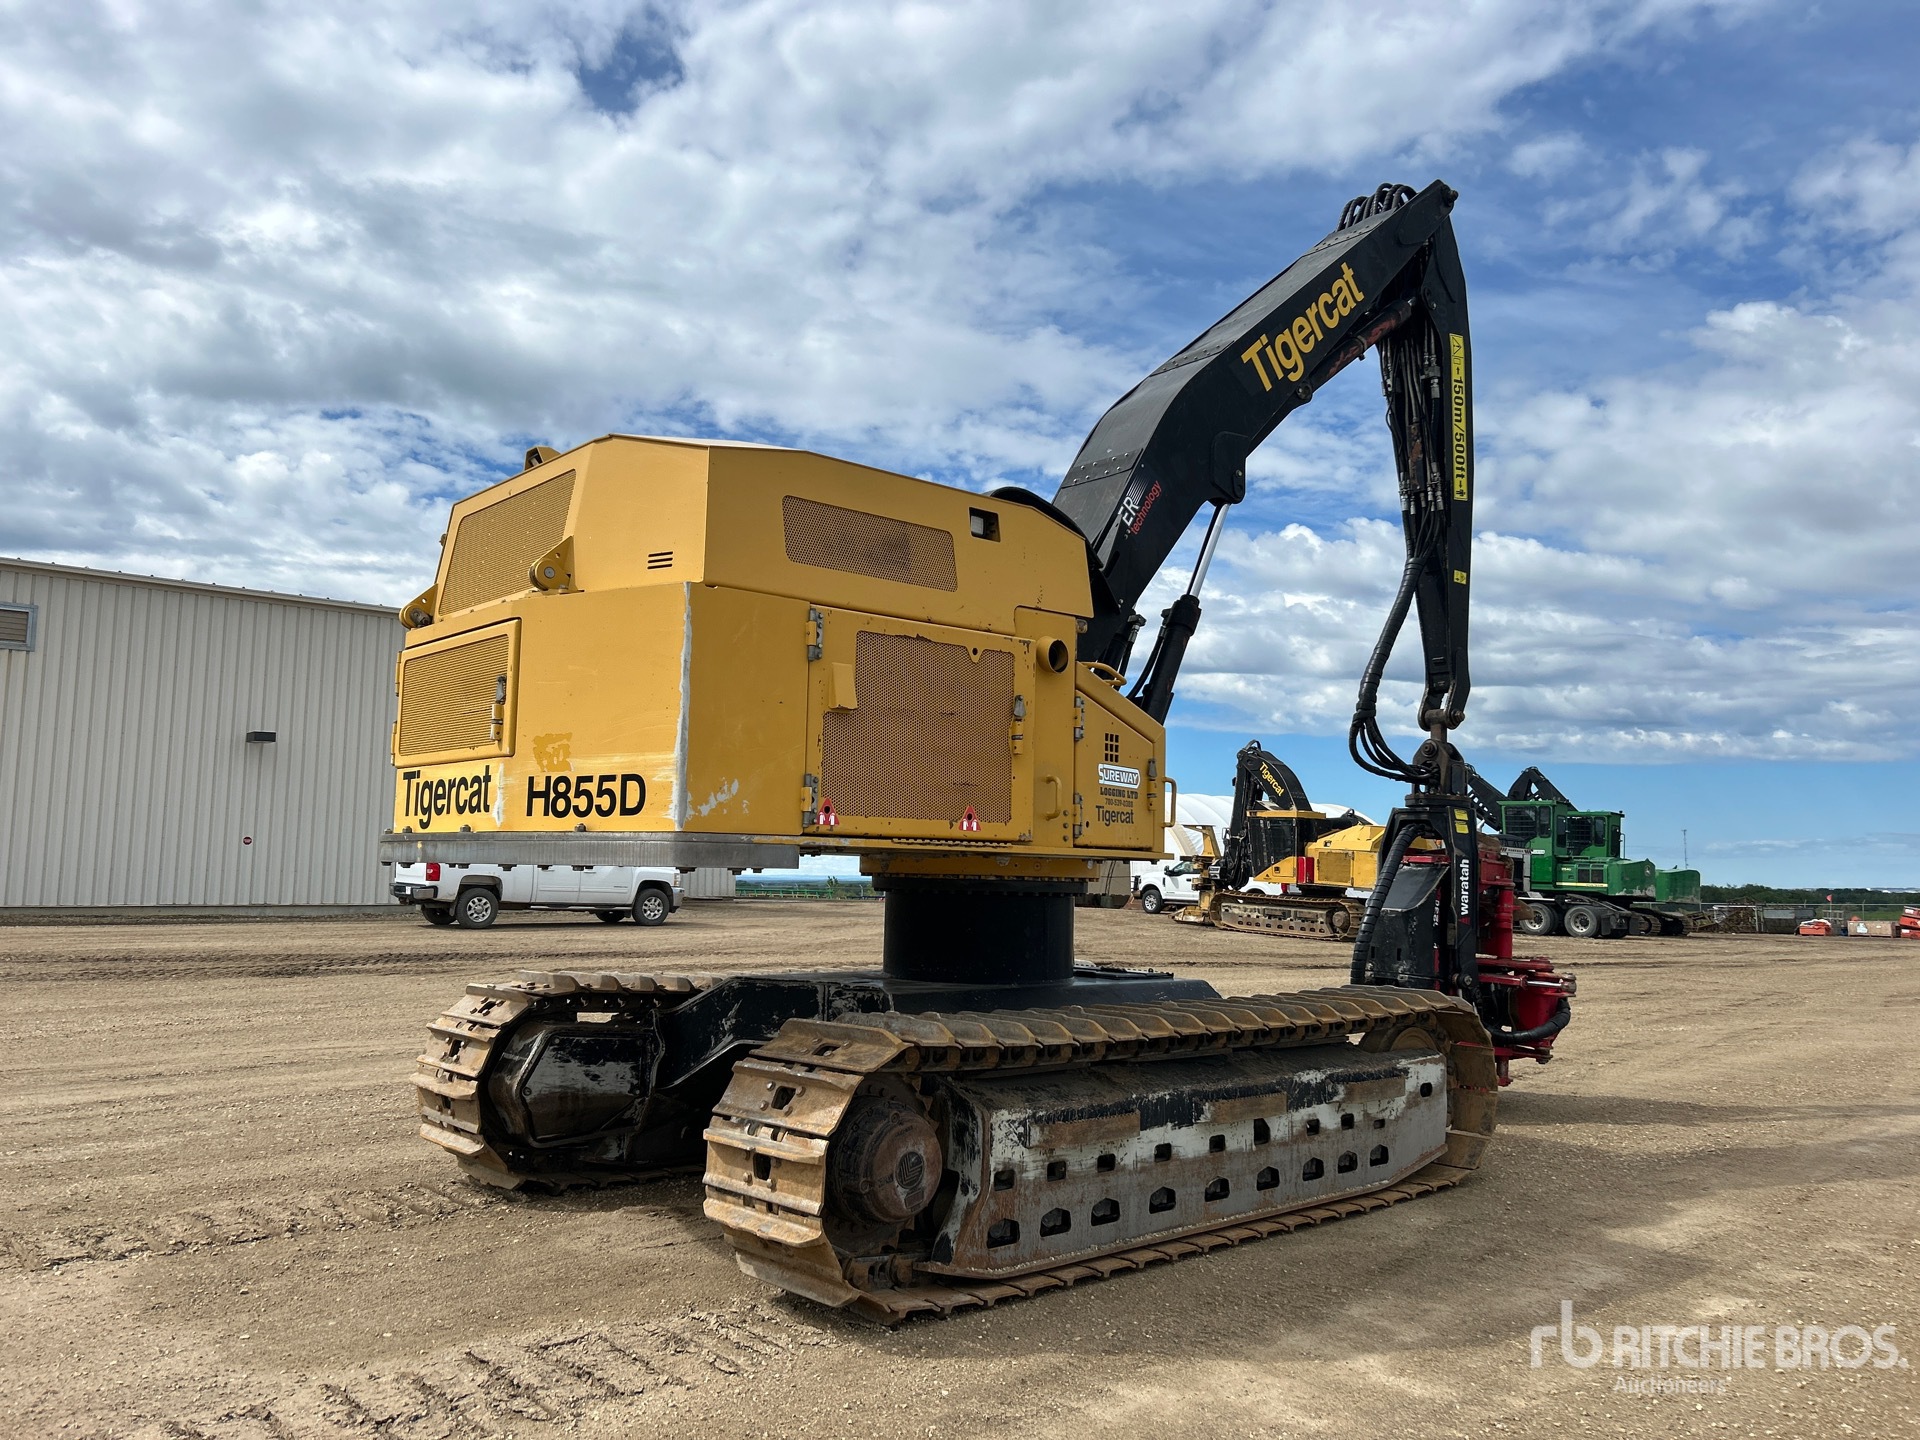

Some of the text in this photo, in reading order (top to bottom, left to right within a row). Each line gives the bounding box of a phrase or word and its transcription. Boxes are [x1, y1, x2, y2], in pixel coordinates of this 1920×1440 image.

[1241, 262, 1365, 392] Tigercat
[1453, 376, 1466, 480] 150m/500ft
[1118, 496, 1140, 527] ER
[1130, 480, 1162, 535] technology
[402, 765, 492, 829] Tigercat
[526, 773, 647, 818] H855D
[1098, 764, 1138, 786] SUREWAY
[1100, 787, 1138, 799] LOGGING LTD
[1260, 762, 1285, 797] Tigercat
[1096, 805, 1134, 826] Tigercat
[1460, 859, 1470, 916] waratah
